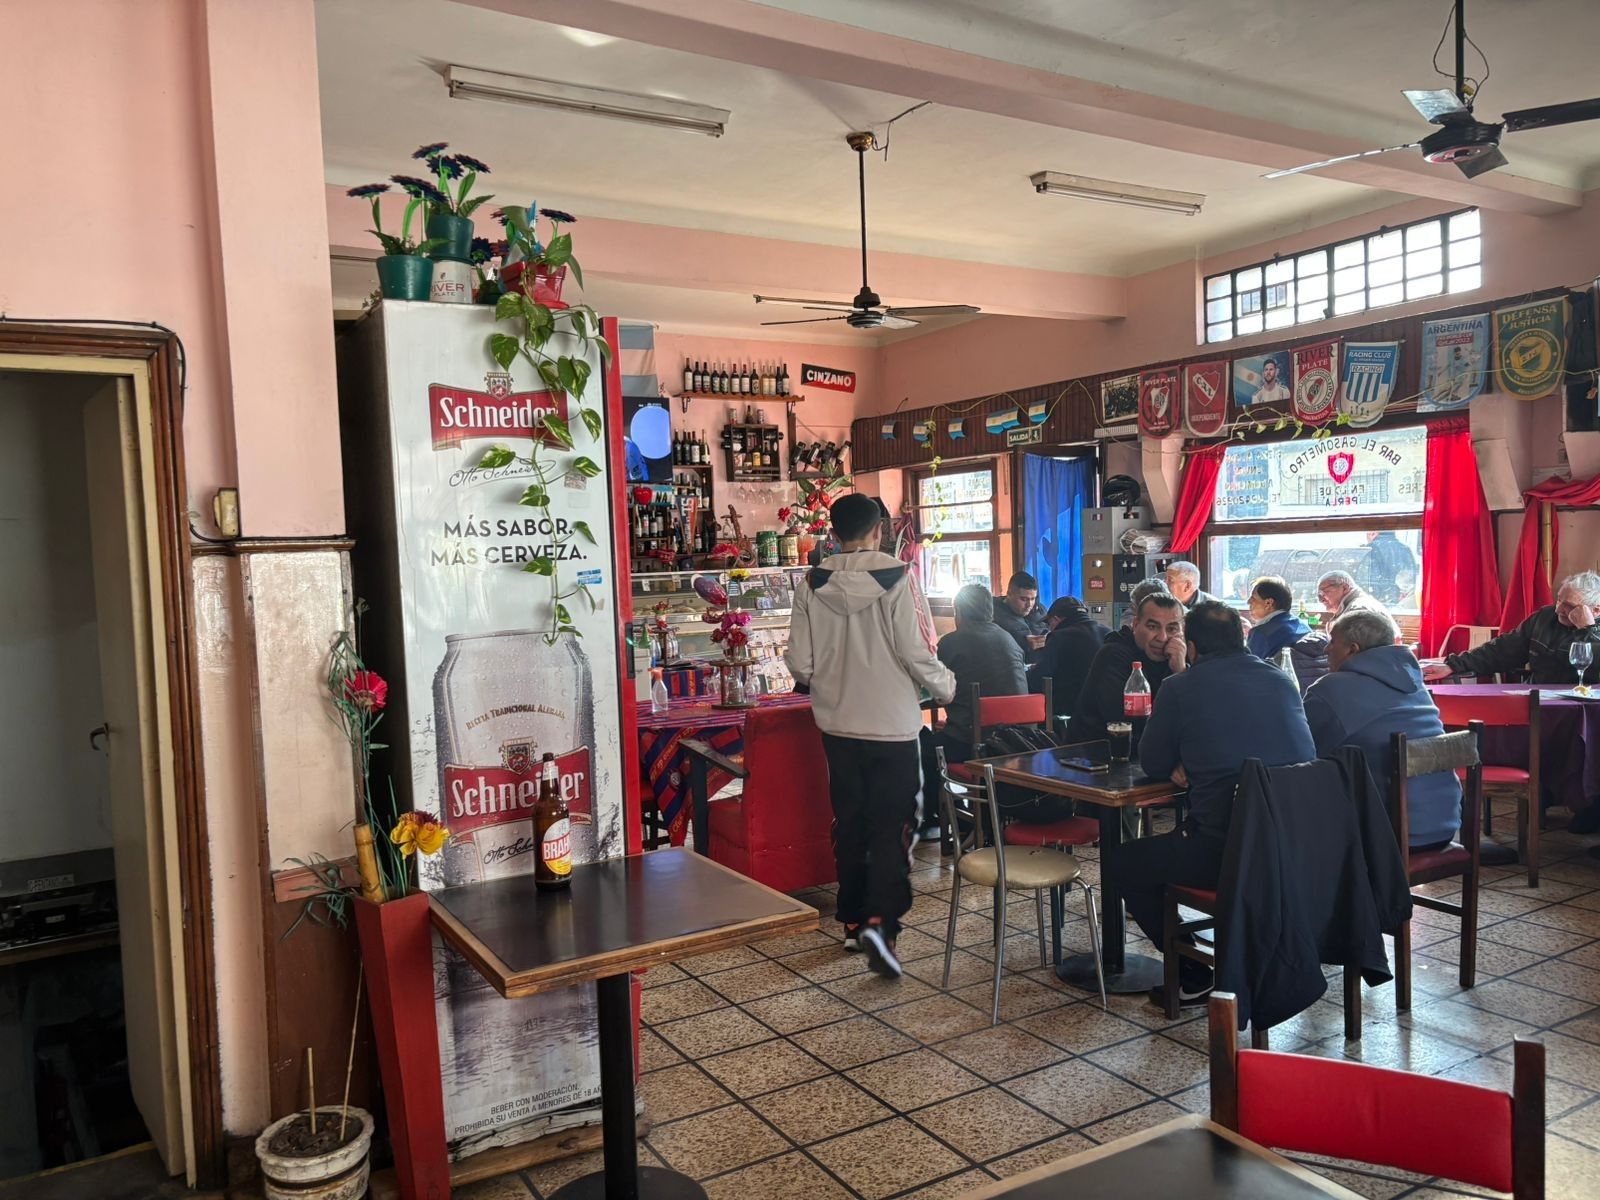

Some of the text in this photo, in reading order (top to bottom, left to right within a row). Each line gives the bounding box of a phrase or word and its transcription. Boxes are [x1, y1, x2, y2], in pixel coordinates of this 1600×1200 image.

[1502, 305, 1557, 324] DEFENSA
[1509, 316, 1552, 330] JUSTICIA
[1427, 320, 1484, 335] ARGENTINA
[1296, 346, 1334, 365] RIVER
[1302, 359, 1329, 371] PLATE
[806, 369, 852, 387] CINZANO
[1351, 365, 1383, 373] RACING
[1009, 433, 1029, 443] SALIDA
[444, 514, 573, 538] MÁS SABOR.
[431, 542, 588, 567] MÁS CERVEZA.
[465, 703, 566, 730] RECETA TRADICIONAL ALEMANA
[452, 771, 585, 818] Schneier
[490, 1083, 580, 1116] BEBER CON MODERACIÓN.
[454, 1118, 495, 1135] PROHIBIDA
[496, 1114, 507, 1124] SU
[508, 1107, 531, 1120] VENTA
[538, 1096, 572, 1111] MENORES
[573, 1092, 583, 1101] DE
[584, 1089, 593, 1098] 18
